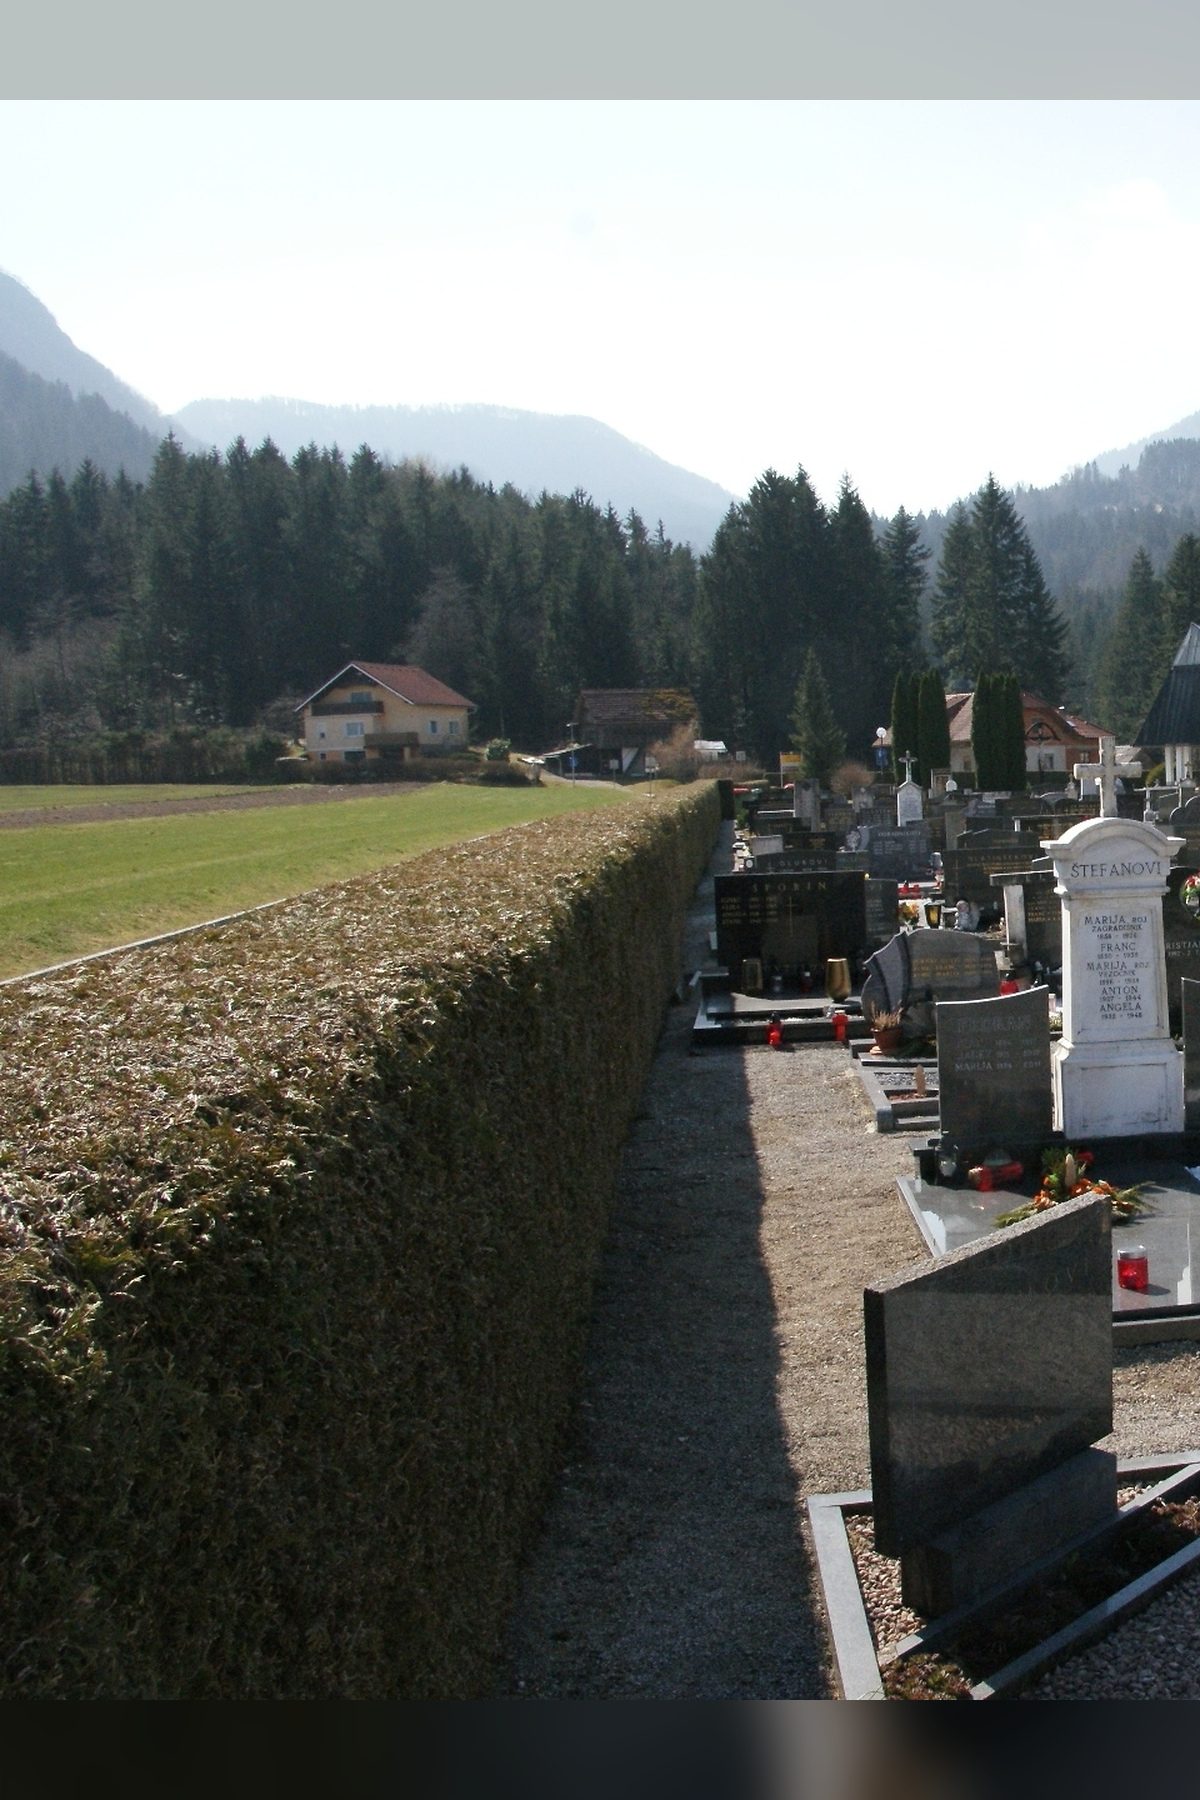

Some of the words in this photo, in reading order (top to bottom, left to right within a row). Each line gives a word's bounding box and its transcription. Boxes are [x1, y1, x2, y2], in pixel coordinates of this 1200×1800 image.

[1070, 861, 1162, 879] ŠTEFANOVI
[1084, 914, 1126, 925] MARIJA
[1100, 942, 1136, 952] FRANC
[1086, 961, 1127, 971] MARIJA
[1101, 986, 1138, 996] ANTON
[1099, 1002, 1142, 1013] ANGELA
